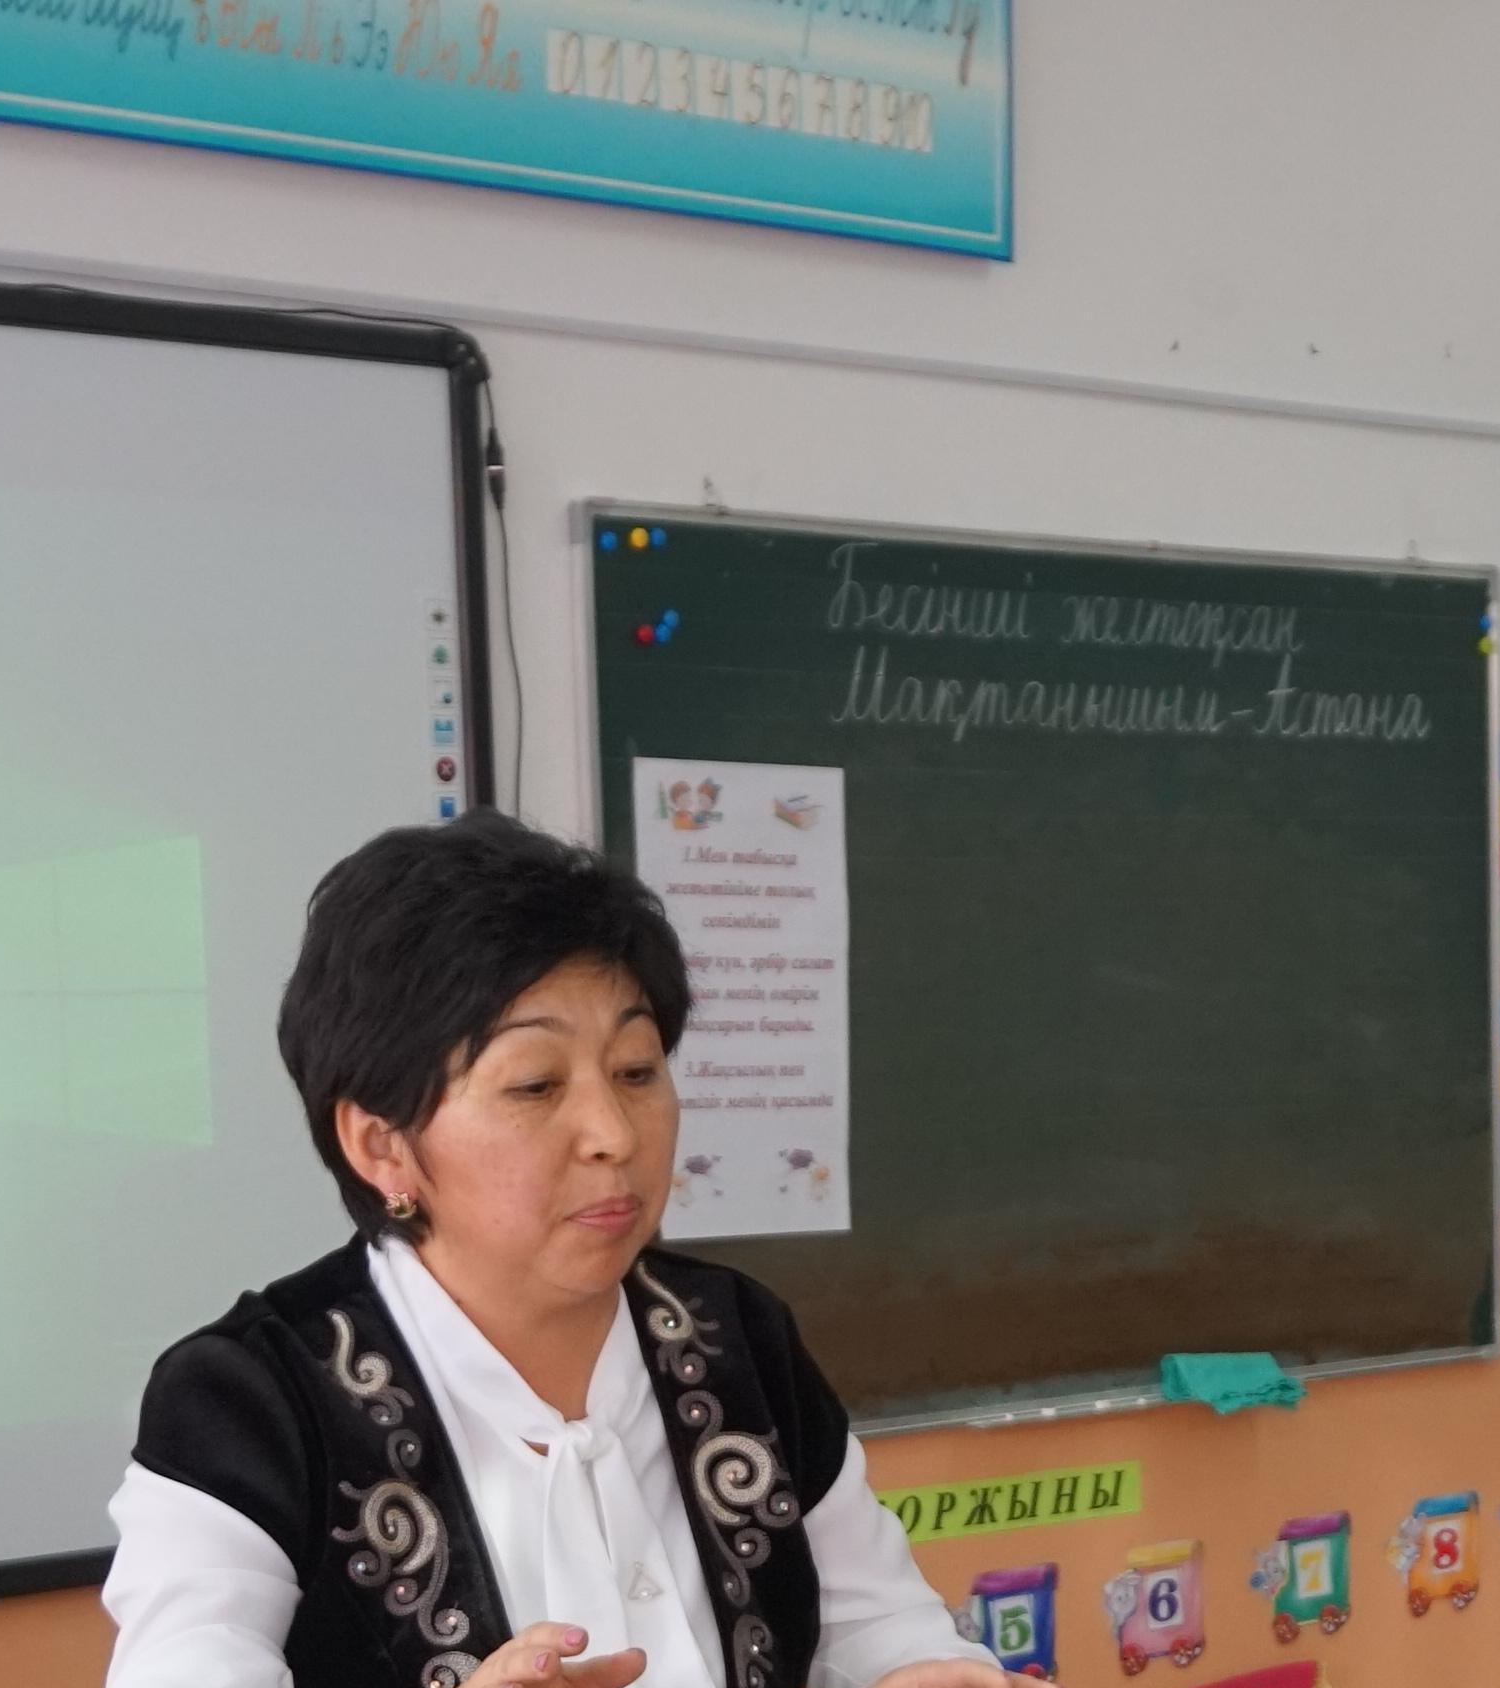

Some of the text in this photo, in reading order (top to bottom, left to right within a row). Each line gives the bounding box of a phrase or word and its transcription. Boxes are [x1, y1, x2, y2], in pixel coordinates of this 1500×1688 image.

[880, 1469, 1126, 1535] ОРЖЫНЫ
[1433, 1526, 1459, 1569] 8
[1299, 1551, 1327, 1592] 7
[1148, 1577, 1179, 1622] 6
[998, 1603, 1033, 1652] 5
